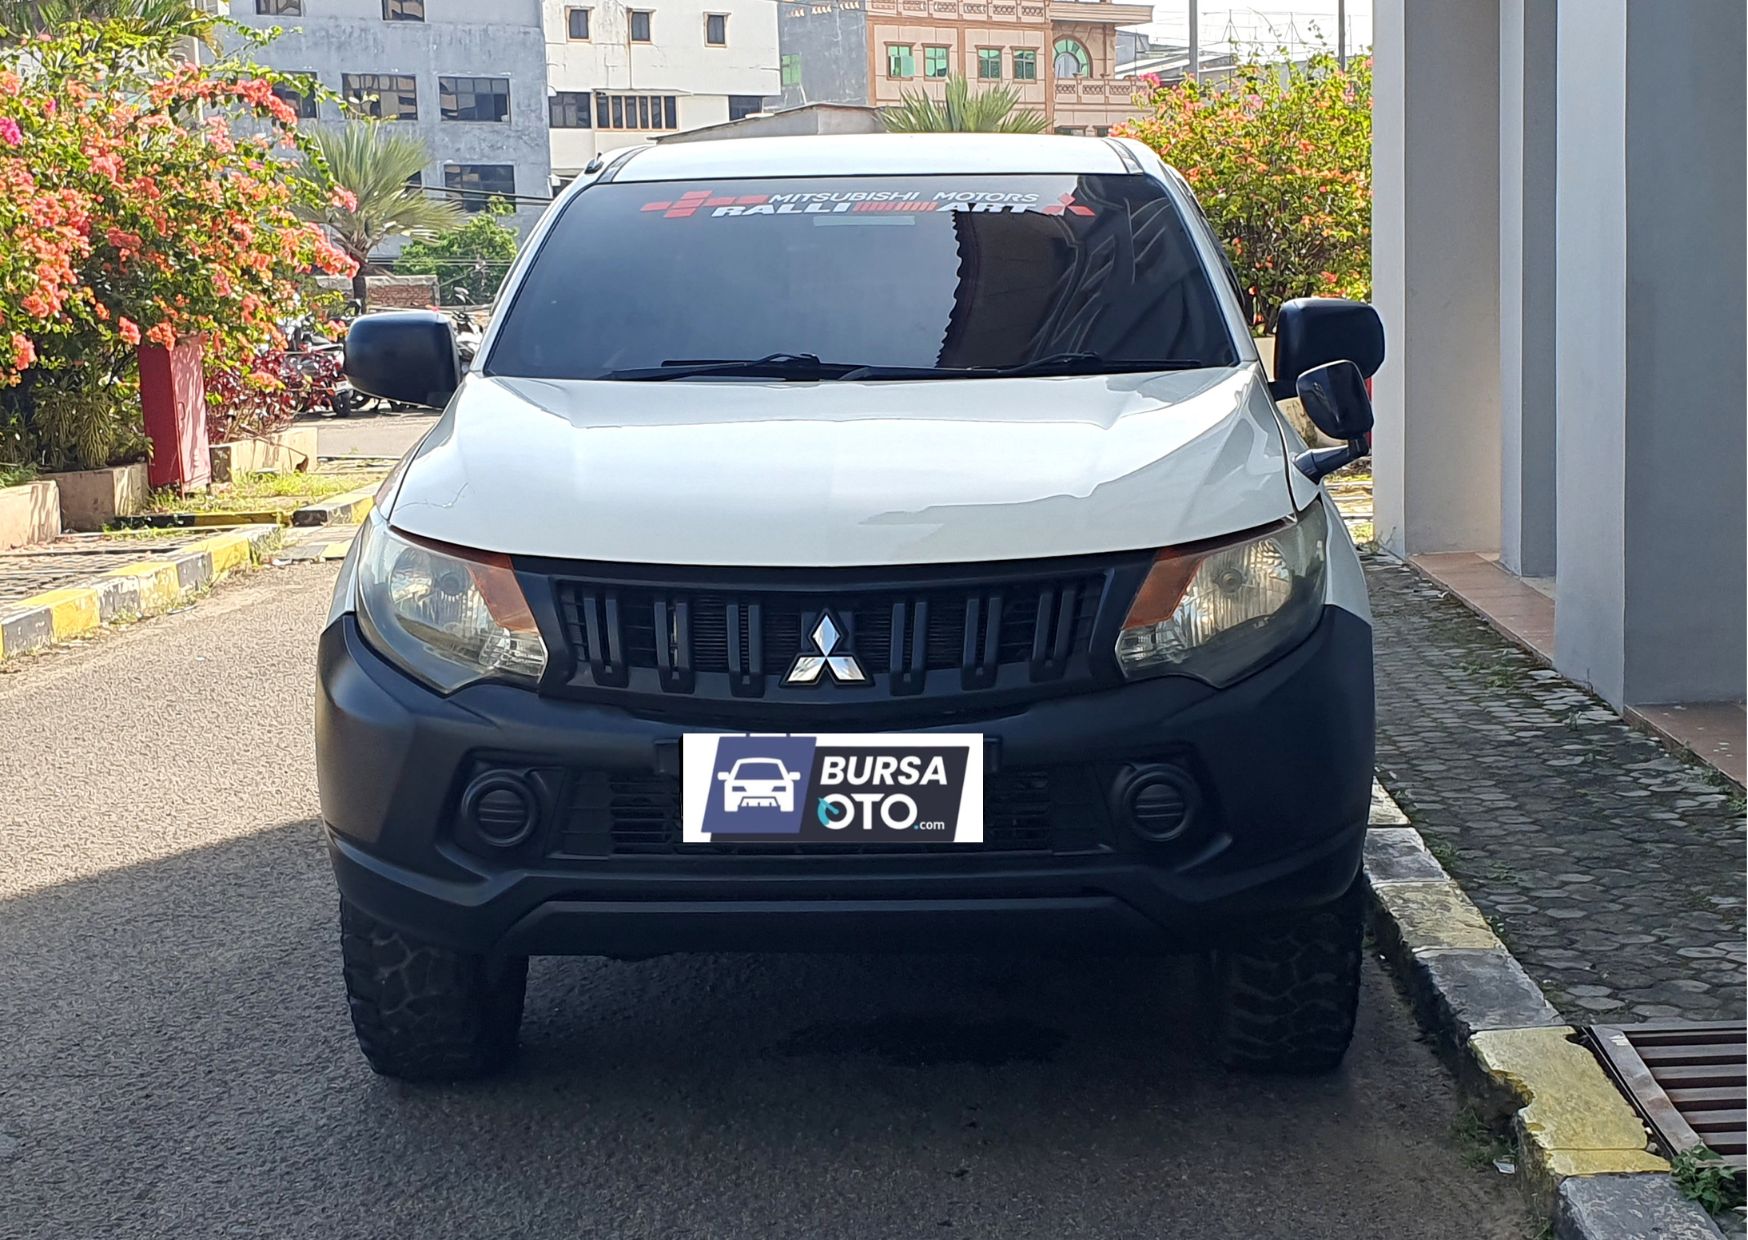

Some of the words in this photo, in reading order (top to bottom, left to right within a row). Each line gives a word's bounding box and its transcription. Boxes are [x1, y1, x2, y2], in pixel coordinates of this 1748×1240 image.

[768, 191, 920, 204] MITSUBISHI
[933, 191, 1040, 202] MOTORS
[711, 202, 852, 218] RALLI
[936, 202, 1037, 213] ART
